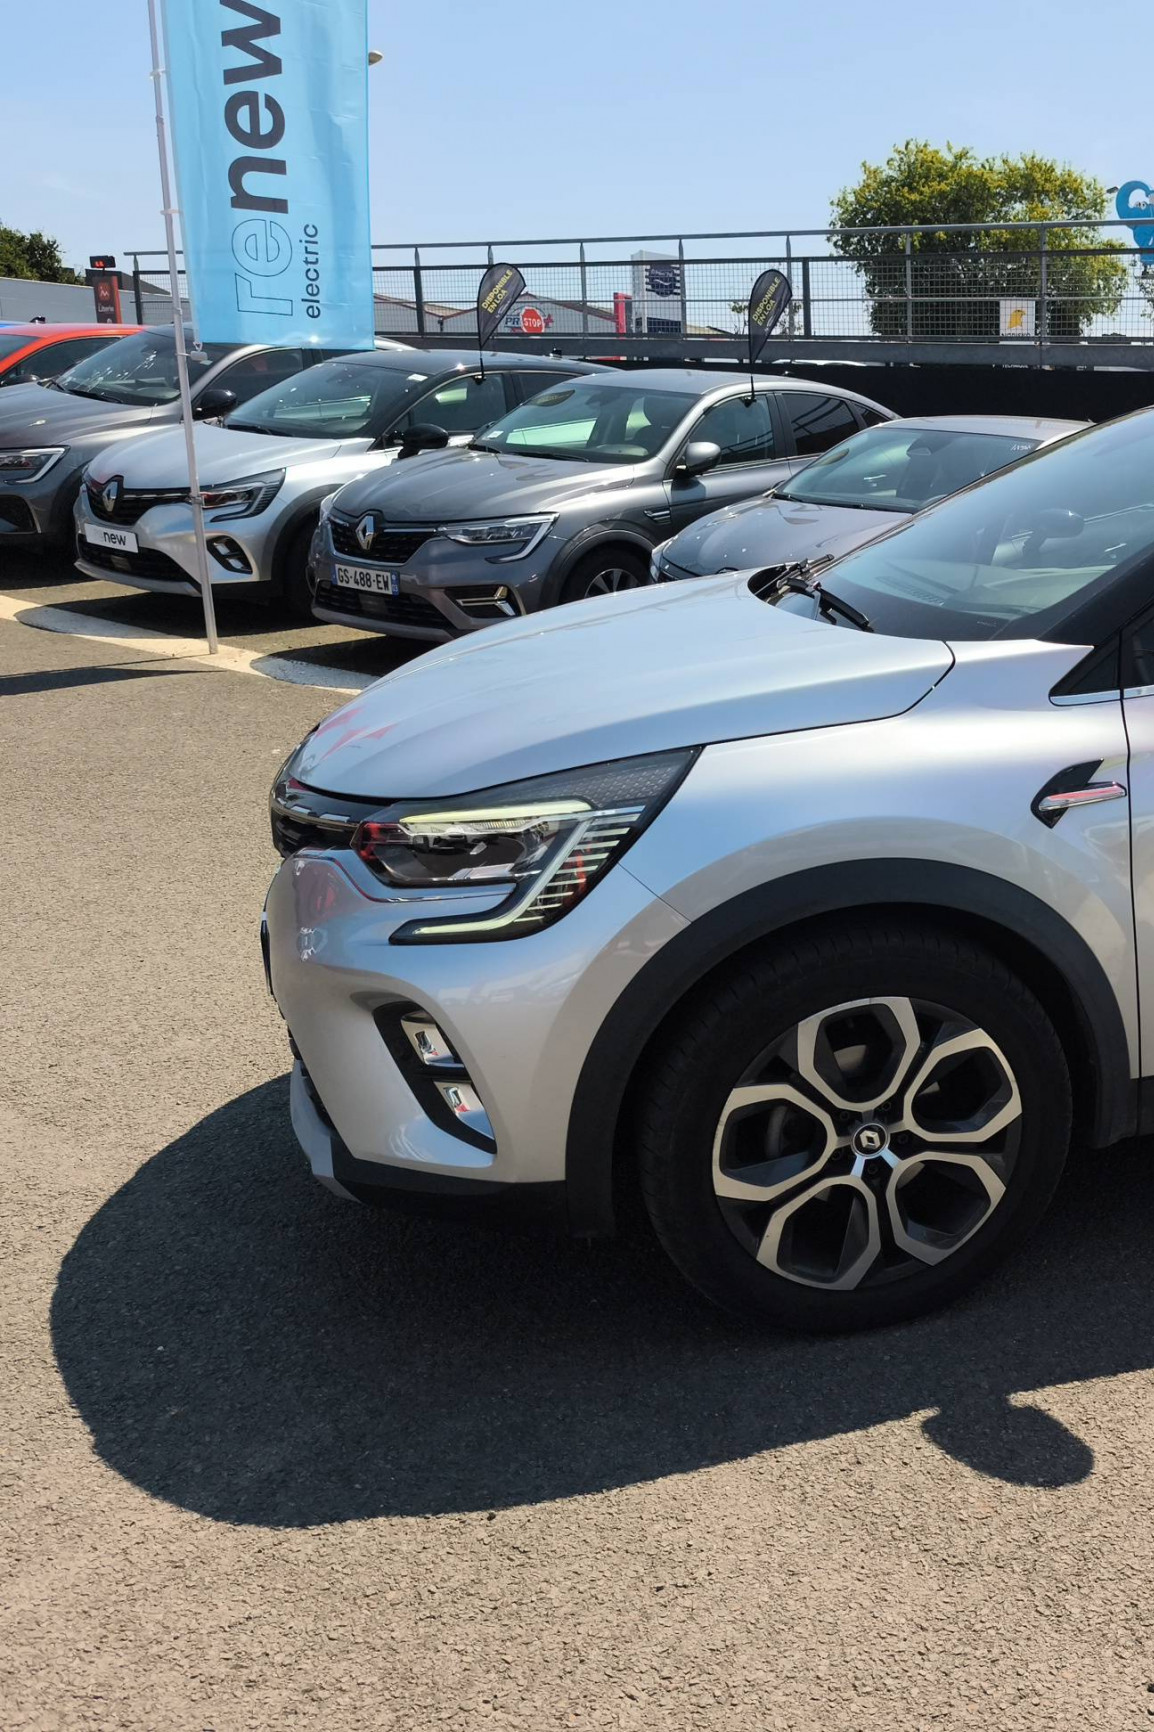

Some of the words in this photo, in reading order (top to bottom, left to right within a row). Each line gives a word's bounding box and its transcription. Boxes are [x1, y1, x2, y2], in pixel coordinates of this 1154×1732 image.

[219, 0, 293, 317] renew
[300, 222, 320, 320] electric
[481, 269, 513, 310] DISPONIBLE
[486, 302, 497, 314] EN
[495, 288, 508, 308] LOA
[752, 276, 781, 321] DISPONIBLE
[523, 317, 542, 328] STOP
[763, 299, 776, 315] LOA
[337, 568, 390, 592] GS-488-EW
